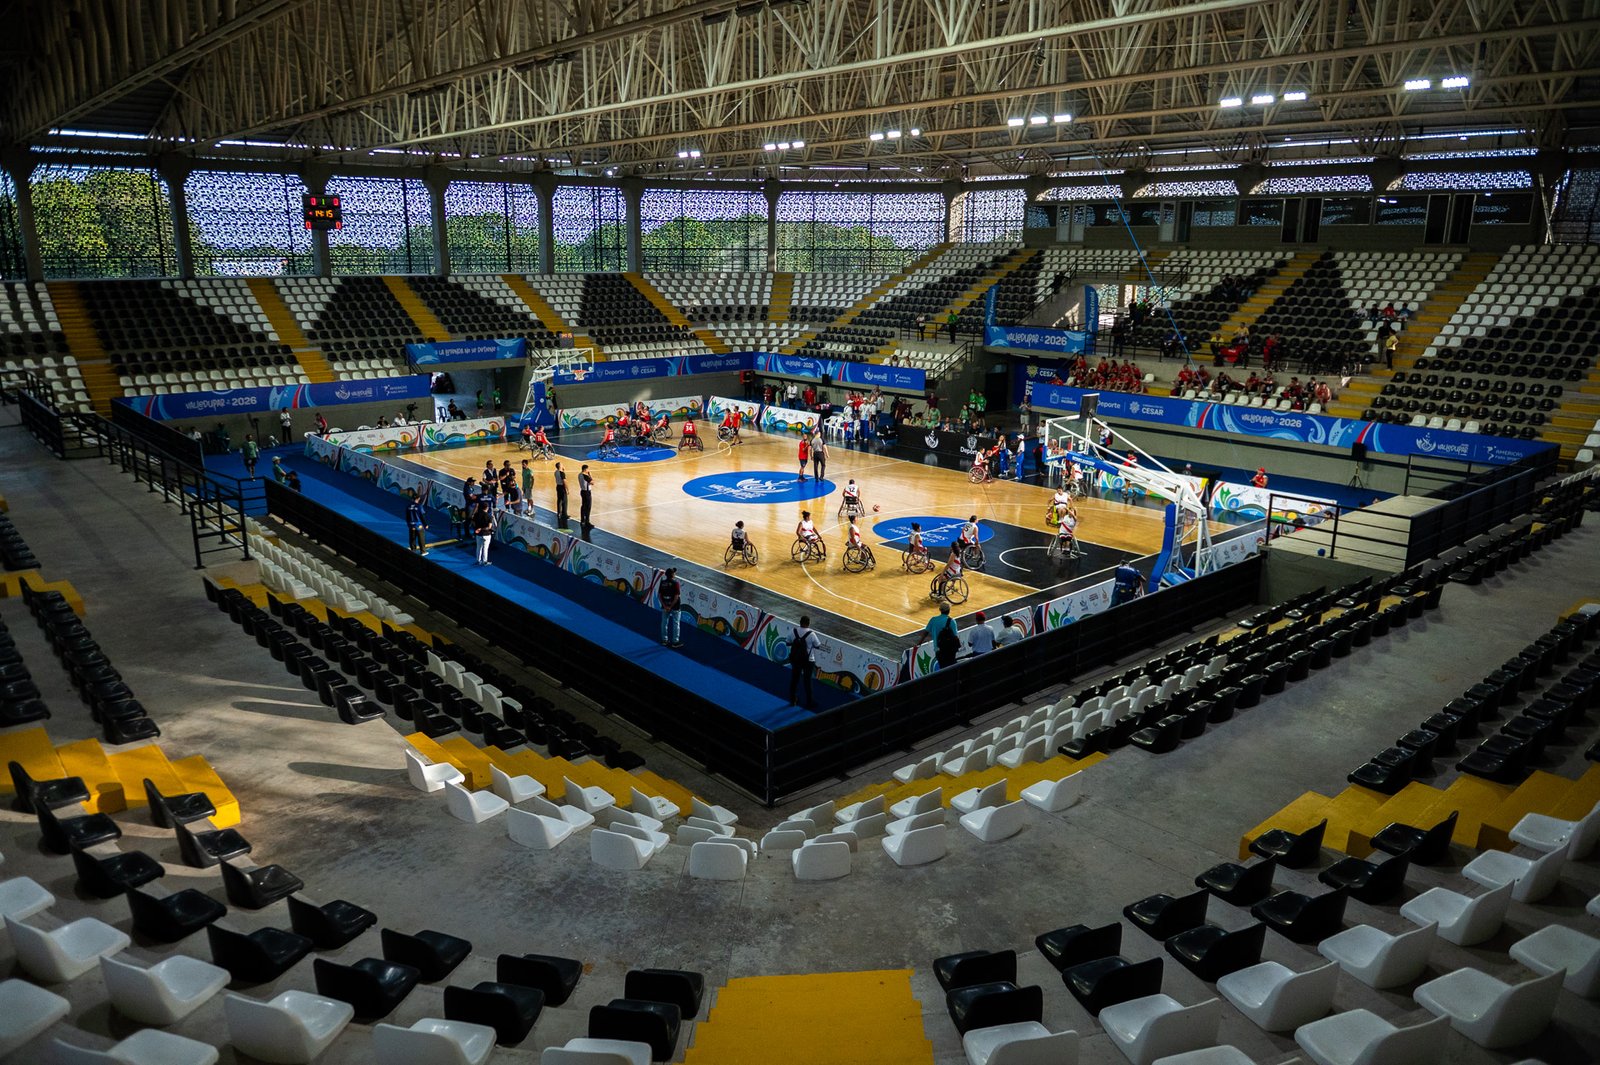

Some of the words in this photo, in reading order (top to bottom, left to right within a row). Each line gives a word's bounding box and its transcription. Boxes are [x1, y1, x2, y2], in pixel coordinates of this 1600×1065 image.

[1044, 335, 1068, 346] 2026
[1039, 370, 1056, 378] CESA
[231, 396, 257, 406] 2026
[1141, 407, 1164, 416] CESAR
[1279, 417, 1302, 428] 2026
